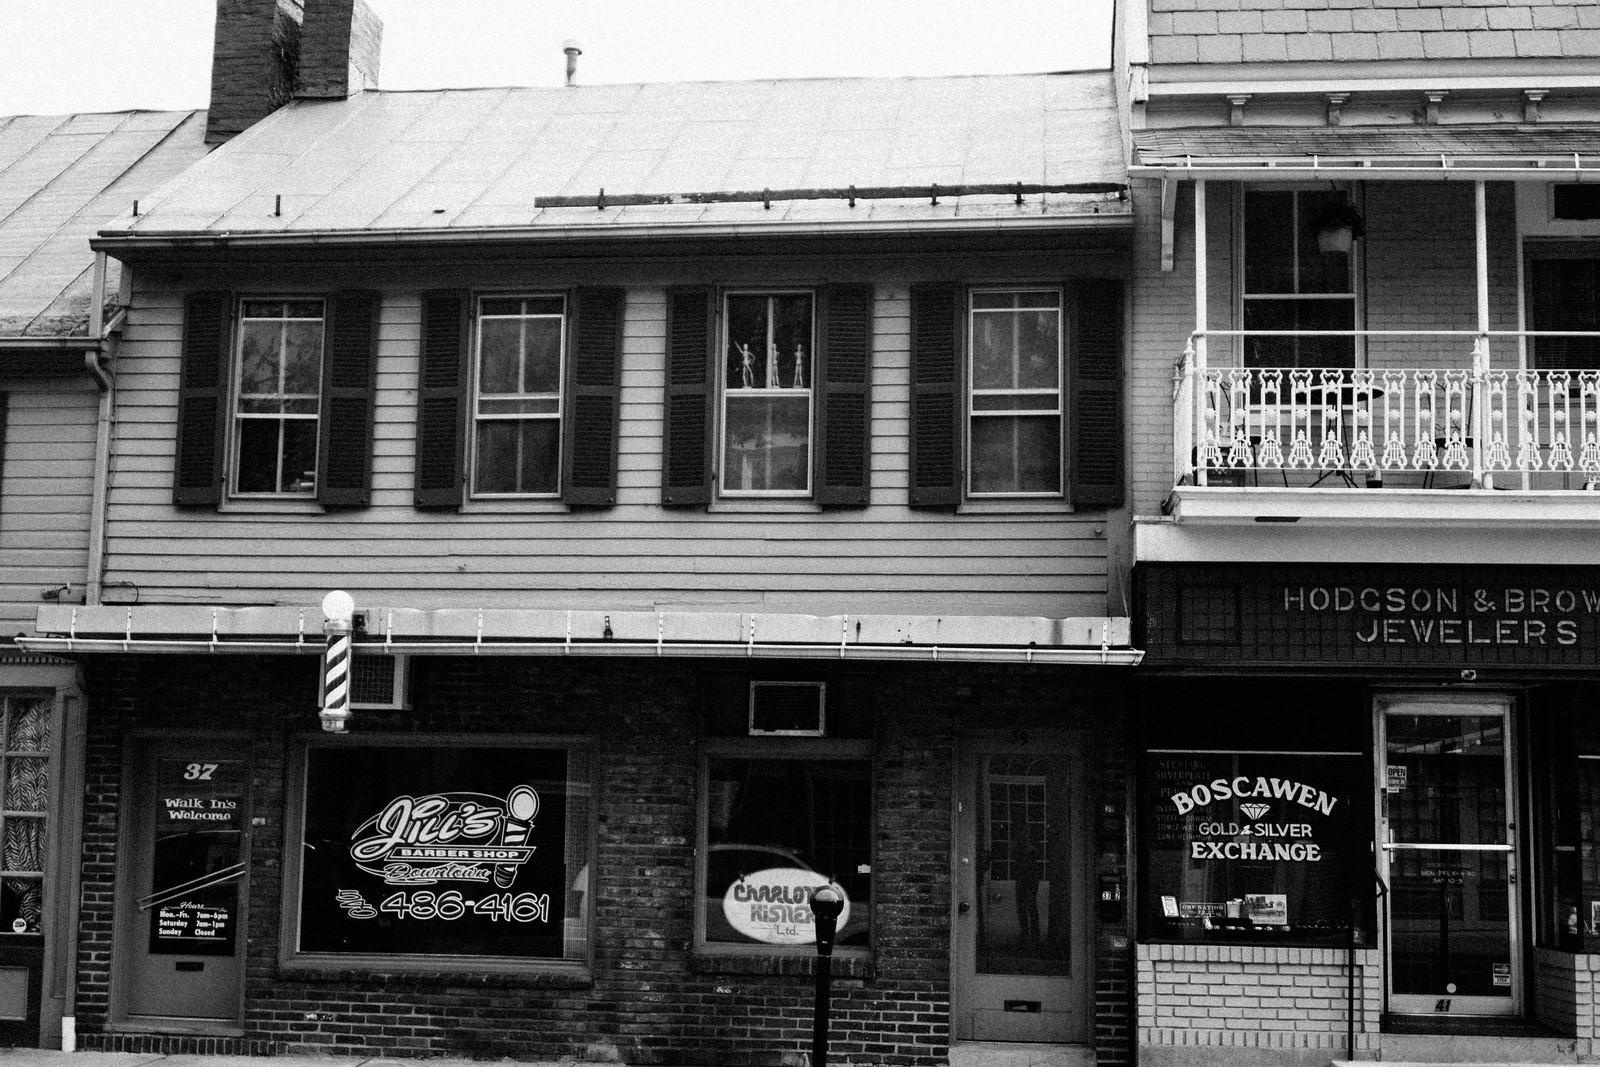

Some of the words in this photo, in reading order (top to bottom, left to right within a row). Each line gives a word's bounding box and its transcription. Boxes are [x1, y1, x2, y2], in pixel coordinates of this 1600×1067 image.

[1283, 587, 1458, 613] HODGSON
[1473, 588, 1497, 613] &
[1355, 619, 1579, 646] JEWELERS
[184, 763, 218, 781] 37
[1388, 768, 1406, 777] OPEN
[1170, 776, 1338, 816] BOSCAWEN
[164, 798, 204, 809] Walk
[210, 798, 237, 810] In's
[168, 810, 231, 821] Welcome
[1198, 822, 1239, 836] GOLD
[1254, 823, 1312, 837] SILVER
[401, 849, 469, 858] BARBER
[472, 849, 519, 859] SHOP
[1191, 841, 1322, 862] EXCHANGE
[384, 863, 491, 881] Downtown
[179, 901, 205, 910] Hours
[380, 890, 550, 923] 486-4161
[159, 919, 188, 928] Saturday
[776, 925, 799, 936] Ltd.
[158, 928, 182, 936] Sunday
[194, 928, 215, 936] Closed
[1434, 999, 1451, 1013] 41
